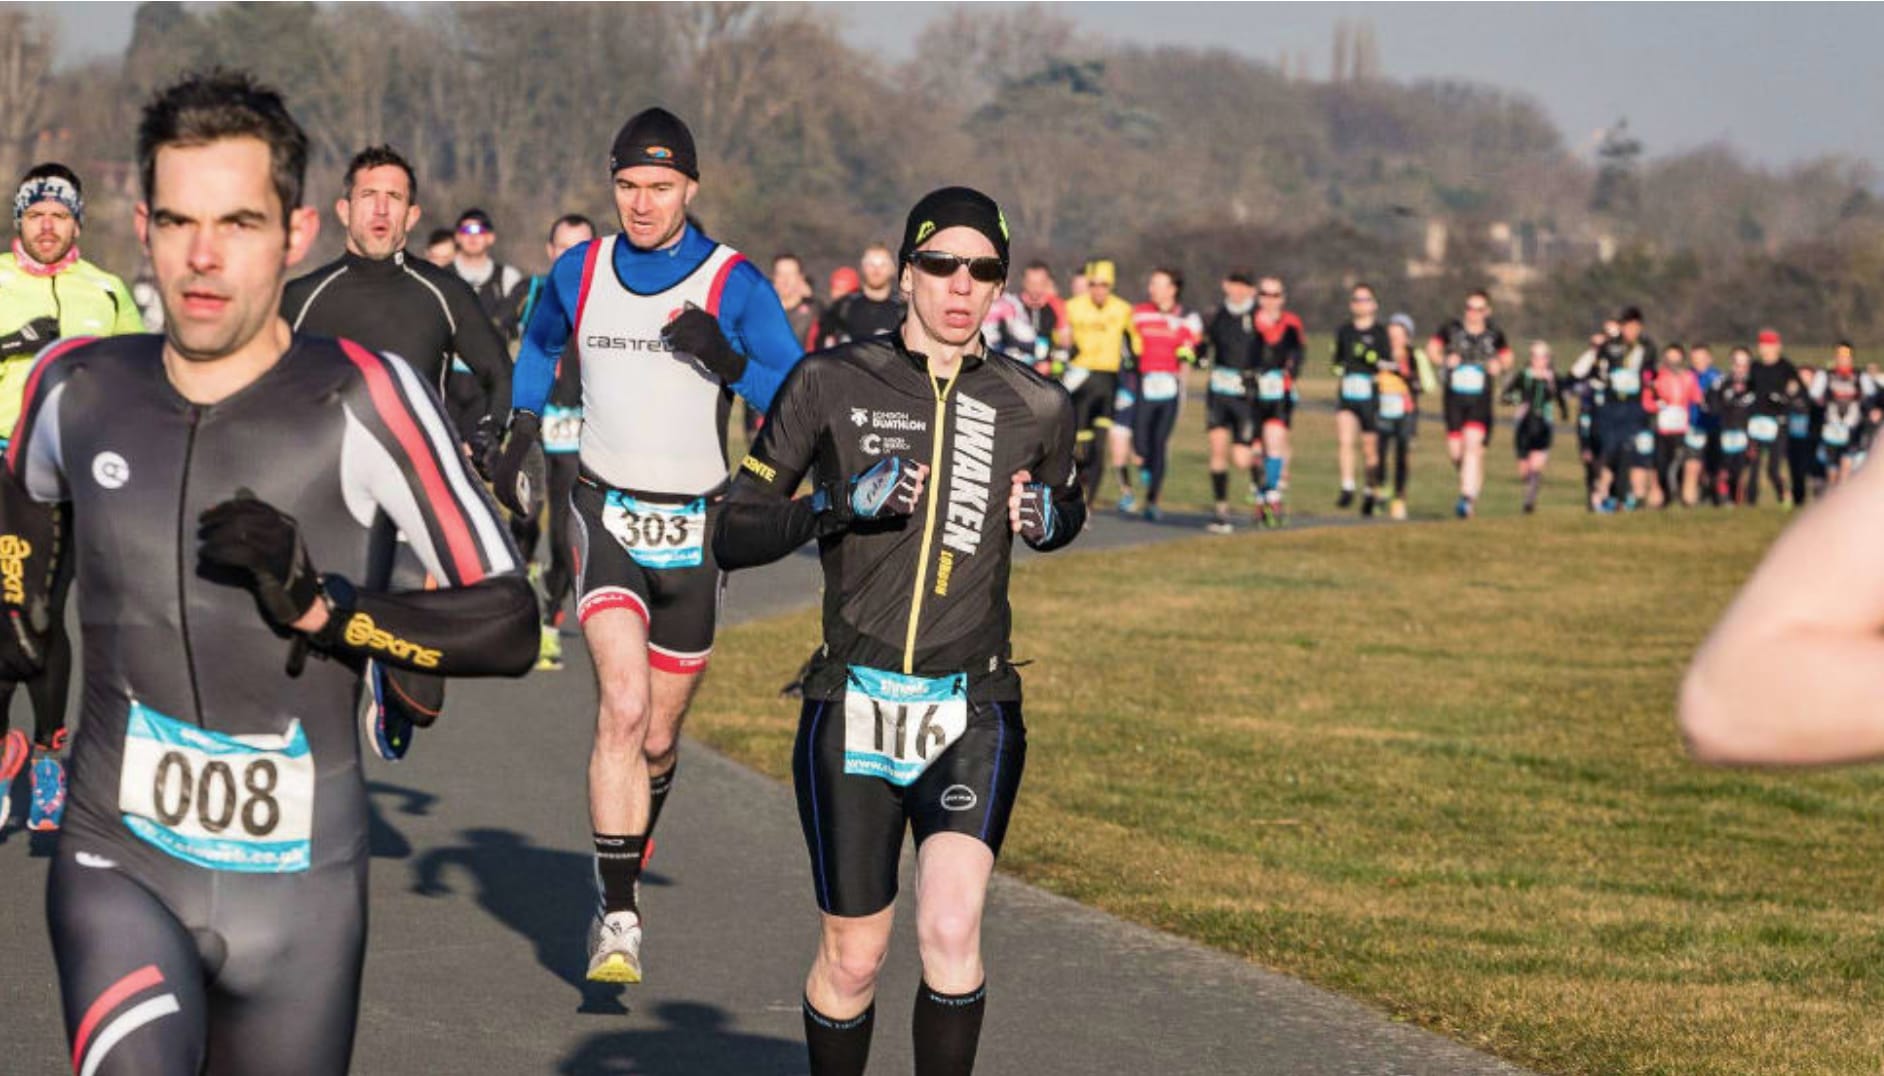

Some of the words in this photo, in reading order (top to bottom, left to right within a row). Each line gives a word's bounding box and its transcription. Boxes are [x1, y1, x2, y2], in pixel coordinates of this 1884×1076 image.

[872, 418, 927, 431] DUATHLON
[943, 391, 997, 555] AWAKEN
[621, 511, 689, 548] 303
[871, 700, 946, 761] 116
[154, 751, 280, 838] 008
